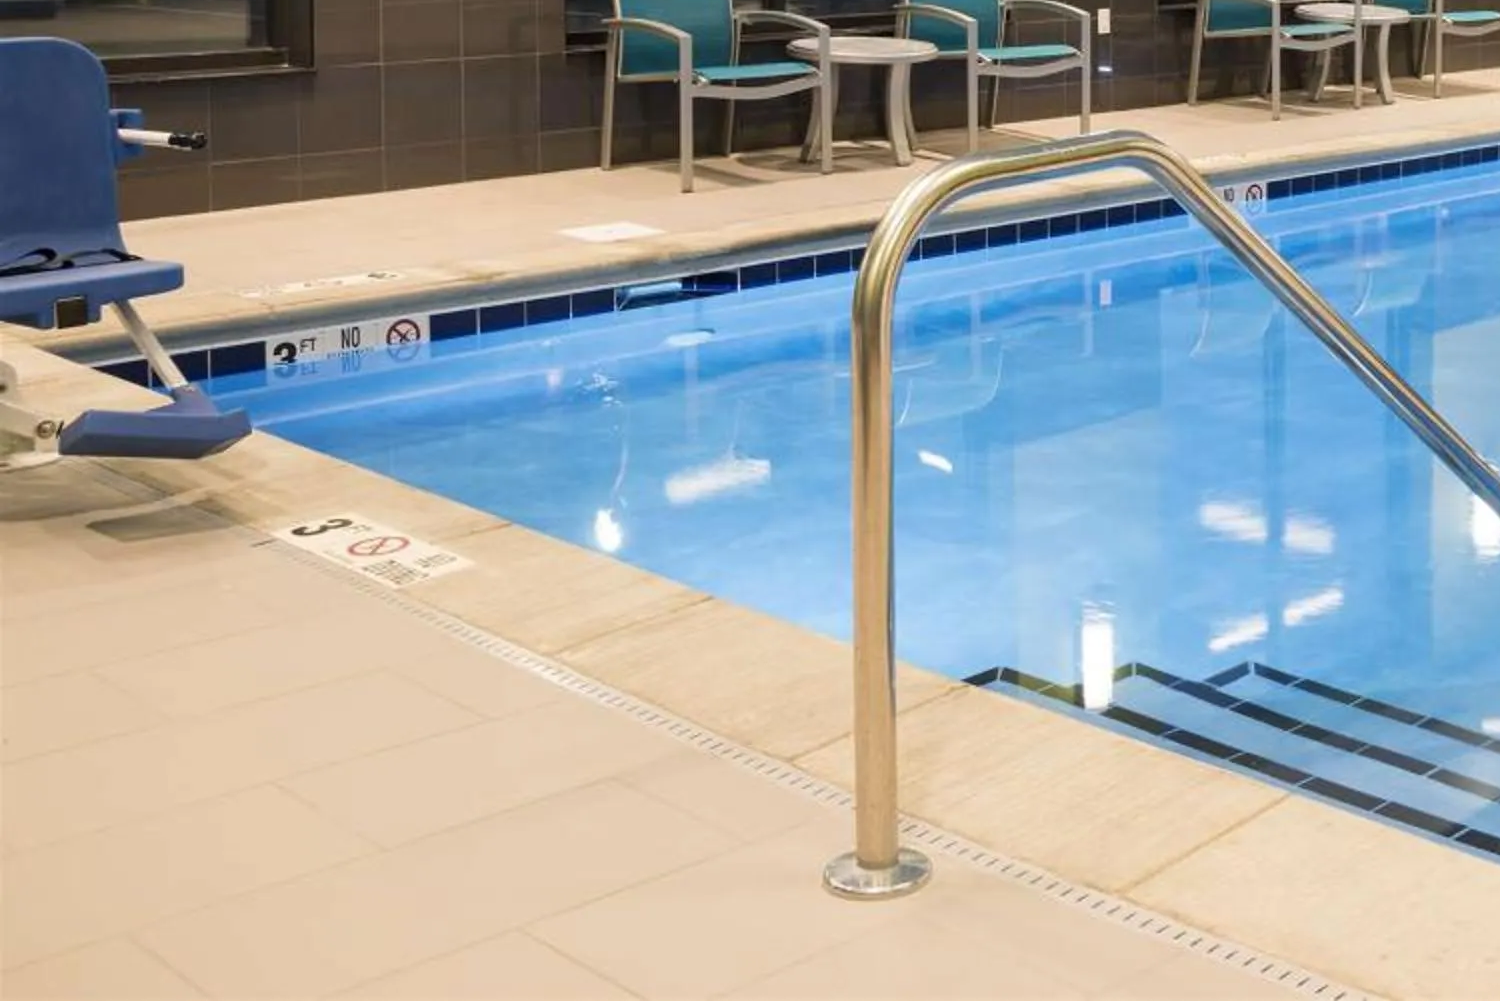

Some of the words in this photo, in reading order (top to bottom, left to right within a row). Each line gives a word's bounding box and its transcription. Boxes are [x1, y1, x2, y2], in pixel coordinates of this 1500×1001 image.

[300, 337, 317, 353] FT
[341, 326, 361, 350] NO
[291, 518, 353, 536] 3
